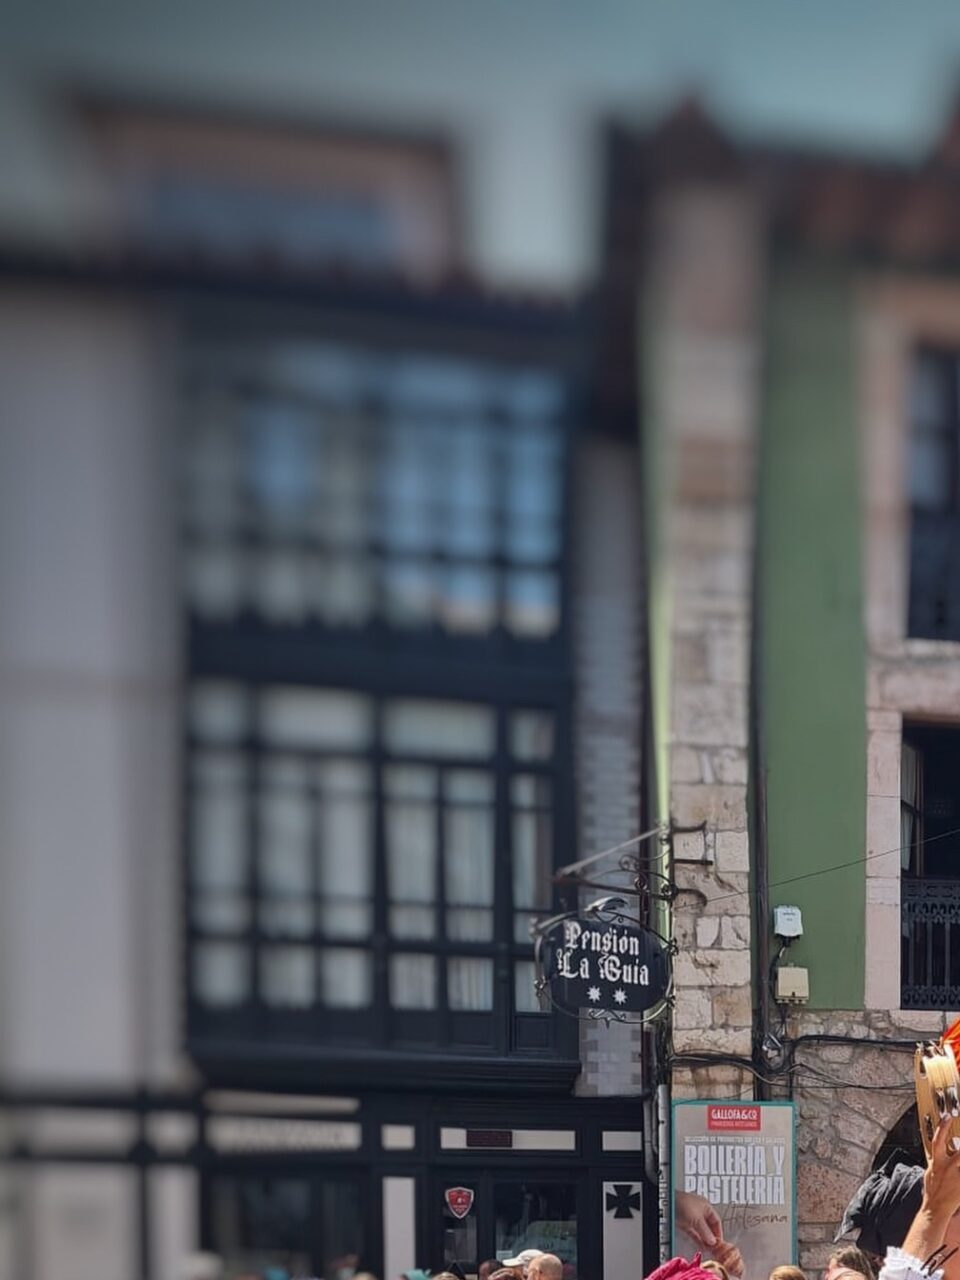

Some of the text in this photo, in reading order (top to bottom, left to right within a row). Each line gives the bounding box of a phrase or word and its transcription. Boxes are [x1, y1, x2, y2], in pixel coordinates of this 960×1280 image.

[564, 920, 640, 956] Pensión
[556, 948, 590, 979] La
[684, 1143, 785, 1175] BOLLERÍA Y
[684, 1174, 785, 1205] PASTELERÍA
[721, 1201, 788, 1231] Artesana
